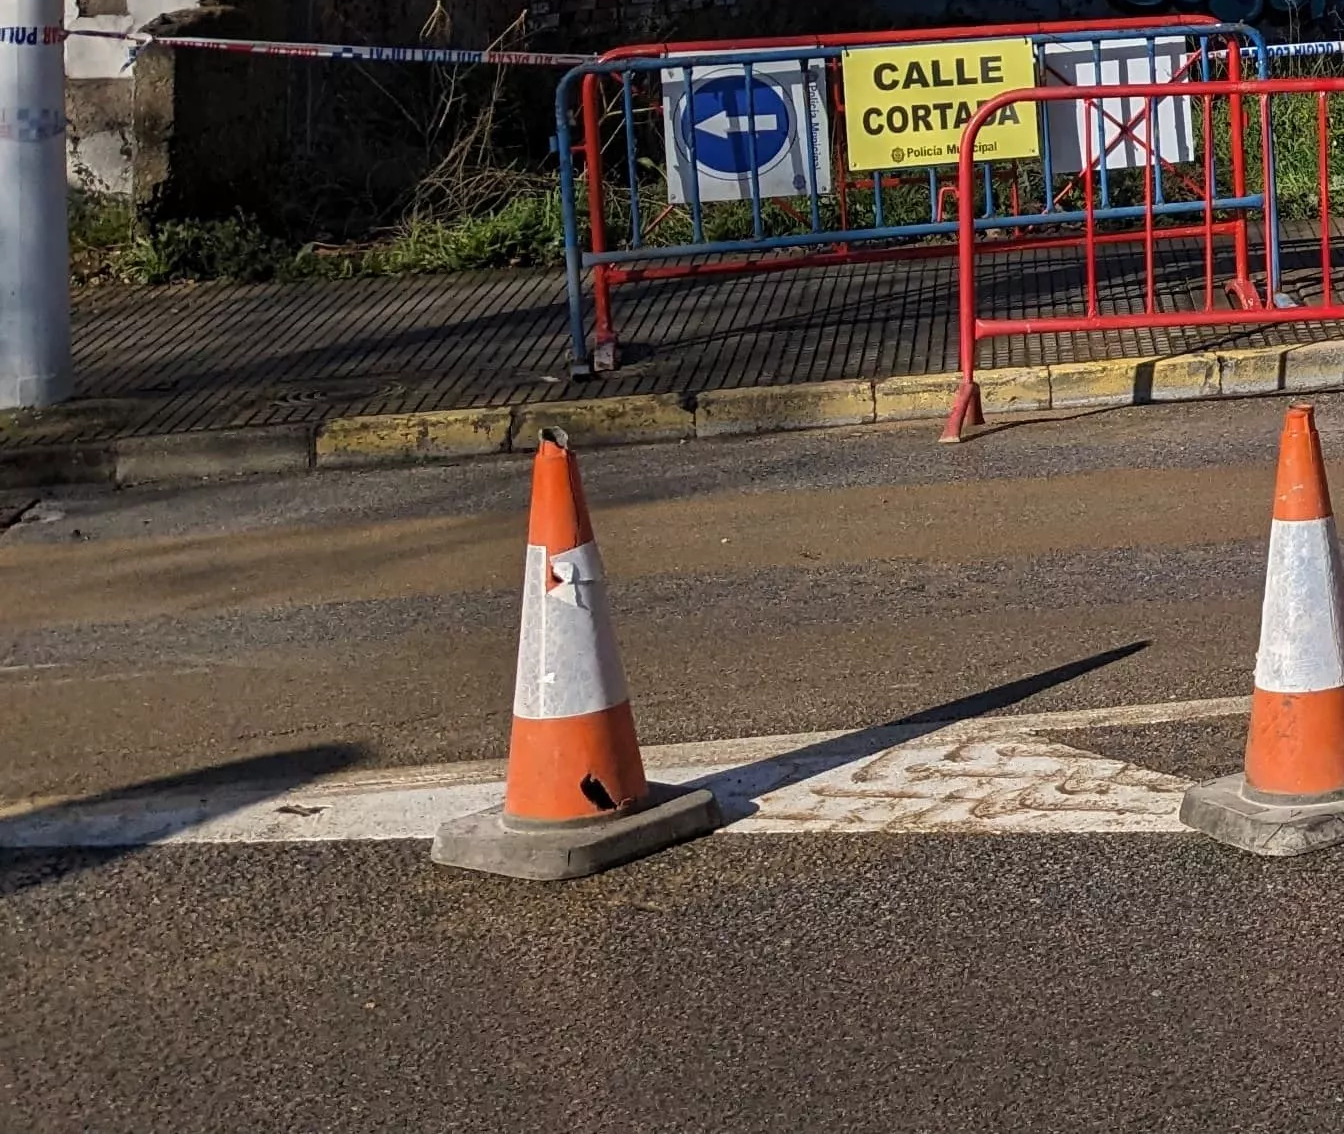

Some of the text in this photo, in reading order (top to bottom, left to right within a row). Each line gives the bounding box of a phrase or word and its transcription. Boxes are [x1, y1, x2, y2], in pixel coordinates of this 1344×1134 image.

[873, 55, 1005, 92] CALLE
[906, 141, 998, 159] Policía Mucipal
